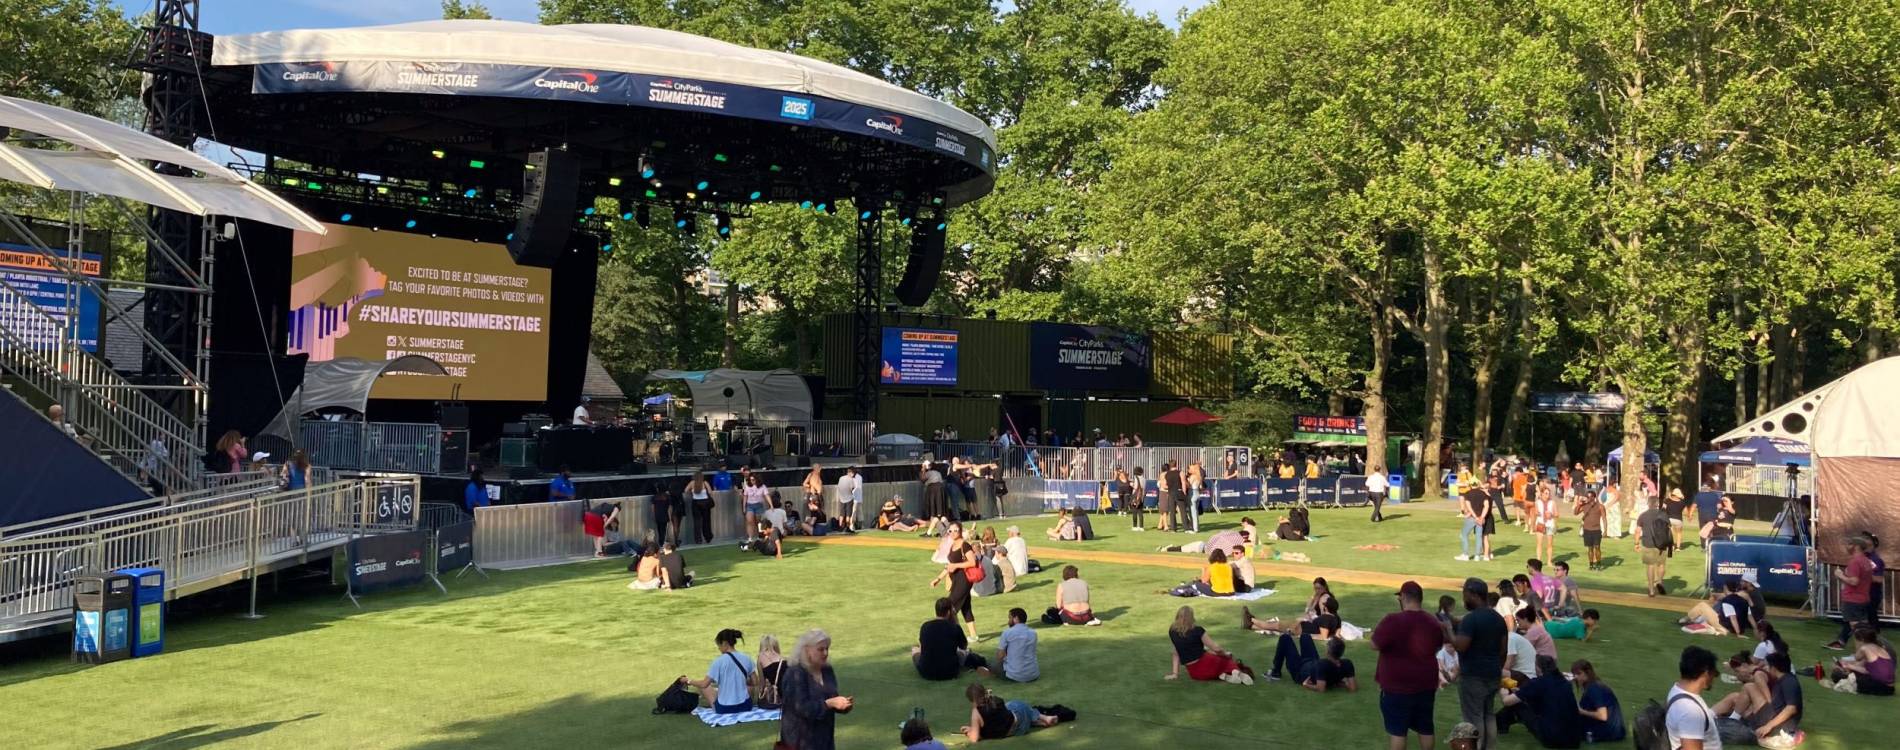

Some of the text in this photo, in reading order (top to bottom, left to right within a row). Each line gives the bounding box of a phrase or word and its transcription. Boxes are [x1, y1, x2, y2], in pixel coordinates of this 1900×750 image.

[398, 72, 479, 87] SUMMERSTAGE
[649, 89, 726, 109] SUMMERSTAGE
[784, 101, 807, 115] 2025
[0, 252, 24, 265] OMING
[25, 255, 35, 265] UP
[36, 257, 46, 267] AT
[408, 266, 529, 288] EXCITED TO BE AT SUMMERSTAGE?
[388, 280, 544, 305] TAG YOUR FAVORITE PHOTOS & VIDEOS WITH
[359, 304, 541, 332] #SHAREYOURSUMMERSTAGE
[409, 337, 464, 350] SUMMERSTAGE
[1059, 349, 1124, 365] SUMMERSTAGE
